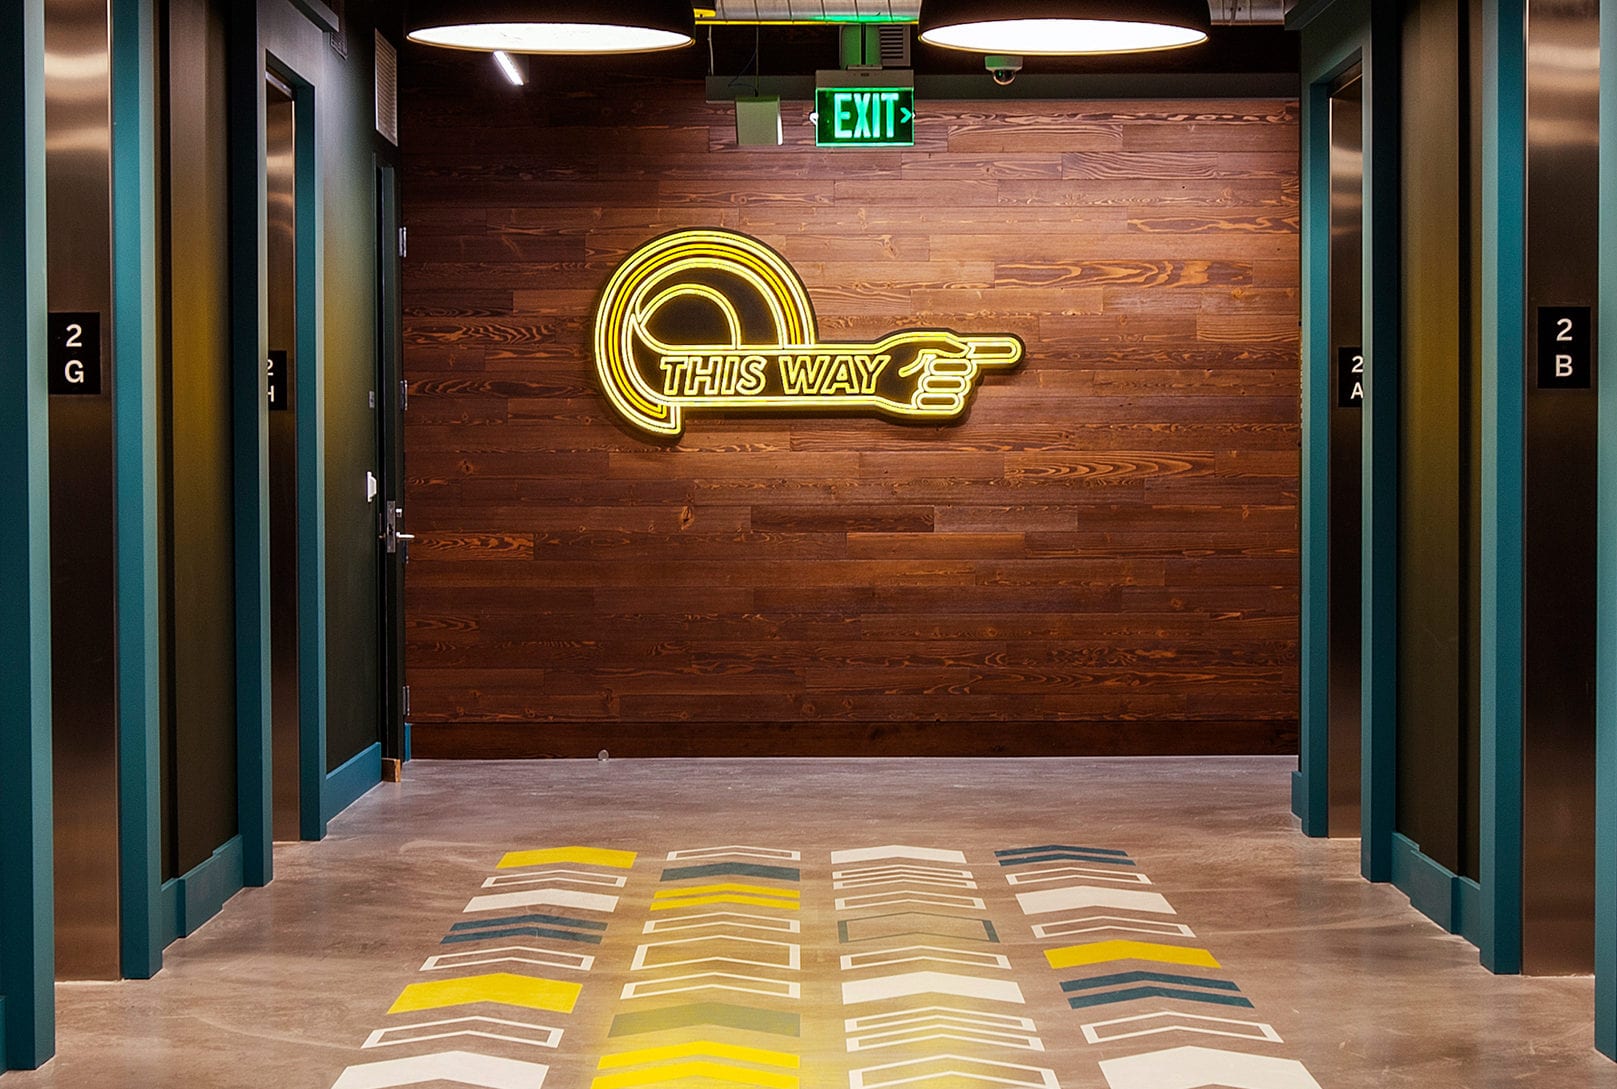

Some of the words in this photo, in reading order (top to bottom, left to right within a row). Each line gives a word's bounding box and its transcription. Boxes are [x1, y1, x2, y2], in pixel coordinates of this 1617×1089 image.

[834, 92, 899, 139] EXIT
[65, 323, 83, 348] 2
[1556, 318, 1573, 341] 2
[64, 359, 85, 384] G
[659, 354, 768, 396] THIS
[777, 354, 892, 395] WAY
[1351, 355, 1364, 373] 2
[1555, 354, 1573, 377] B
[1350, 381, 1364, 399] A
